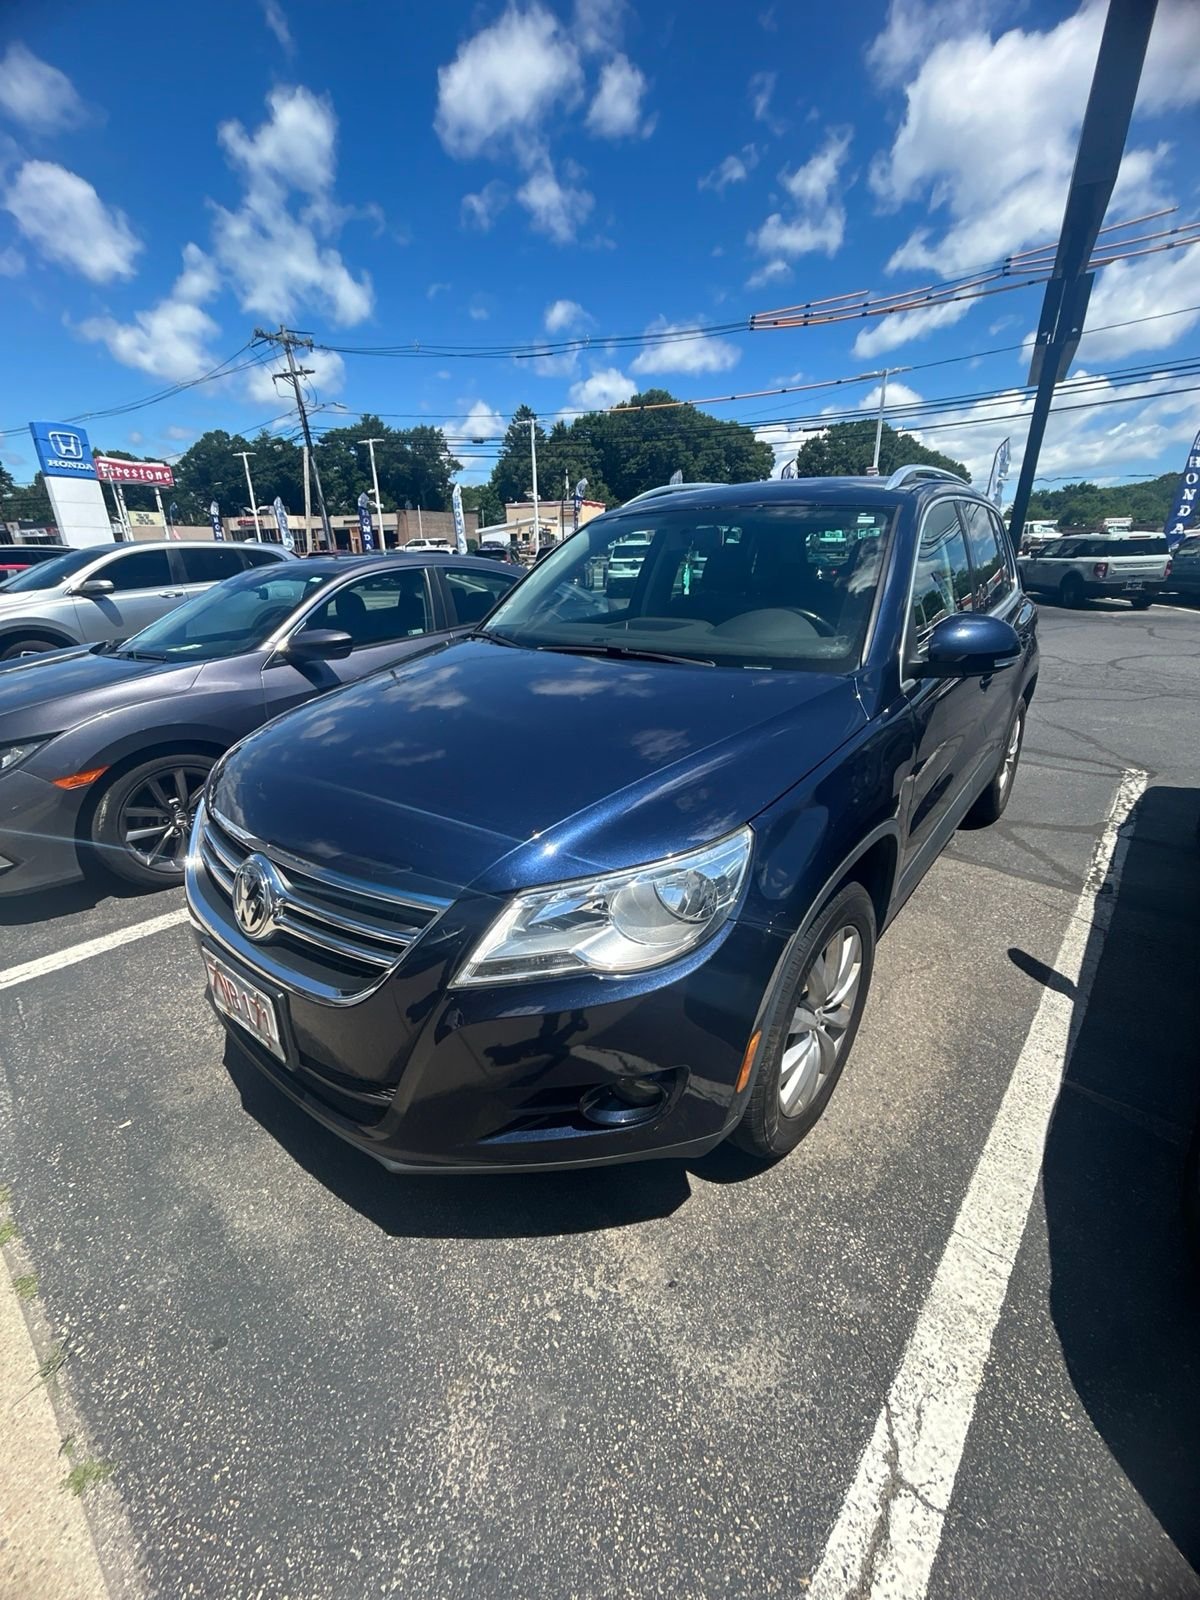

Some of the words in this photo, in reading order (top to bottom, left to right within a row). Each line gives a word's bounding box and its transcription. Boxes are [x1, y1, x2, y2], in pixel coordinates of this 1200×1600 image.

[47, 459, 95, 472] HONDA
[97, 462, 171, 482] Firestone
[1169, 455, 1200, 535] HONDA
[362, 508, 373, 550] HONDA
